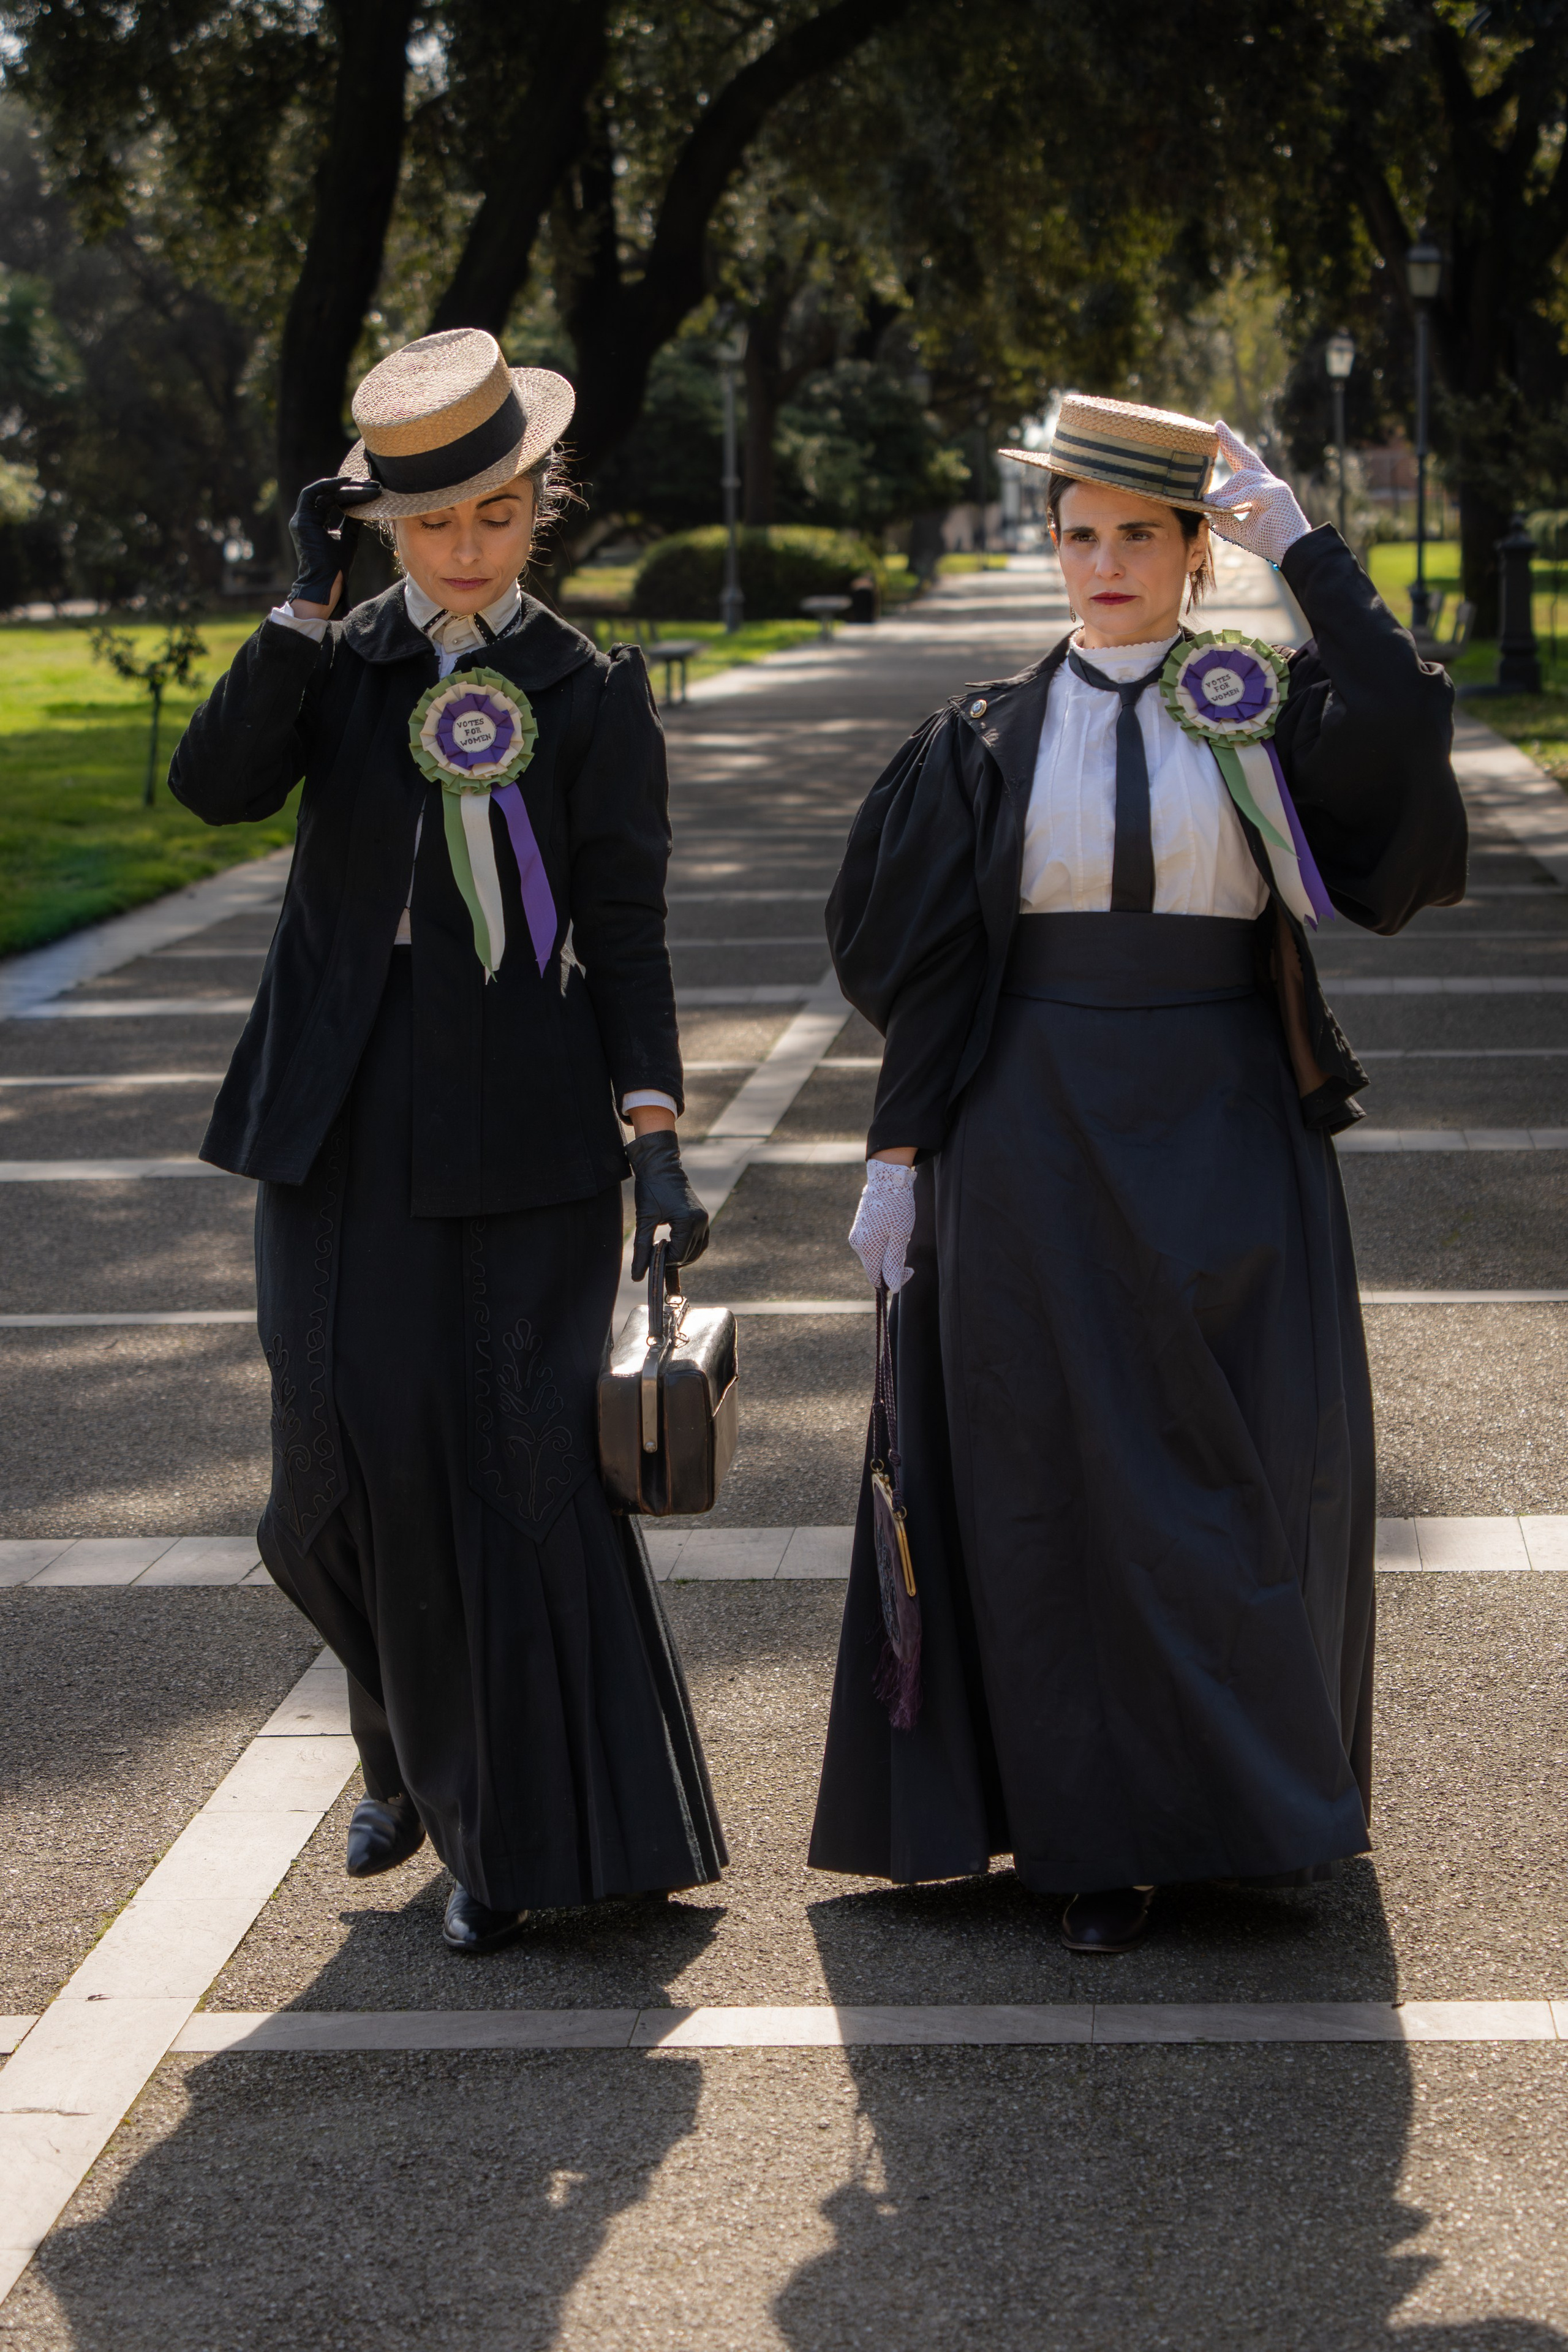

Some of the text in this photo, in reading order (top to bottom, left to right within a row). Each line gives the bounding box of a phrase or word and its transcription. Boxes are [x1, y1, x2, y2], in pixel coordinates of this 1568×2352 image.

[1205, 674, 1231, 688] VOTES
[1213, 682, 1230, 693] FOR
[1211, 688, 1240, 701] WOMEN
[456, 718, 484, 728] VOTES
[464, 727, 481, 736] FOR
[460, 733, 491, 746] WOMEN
